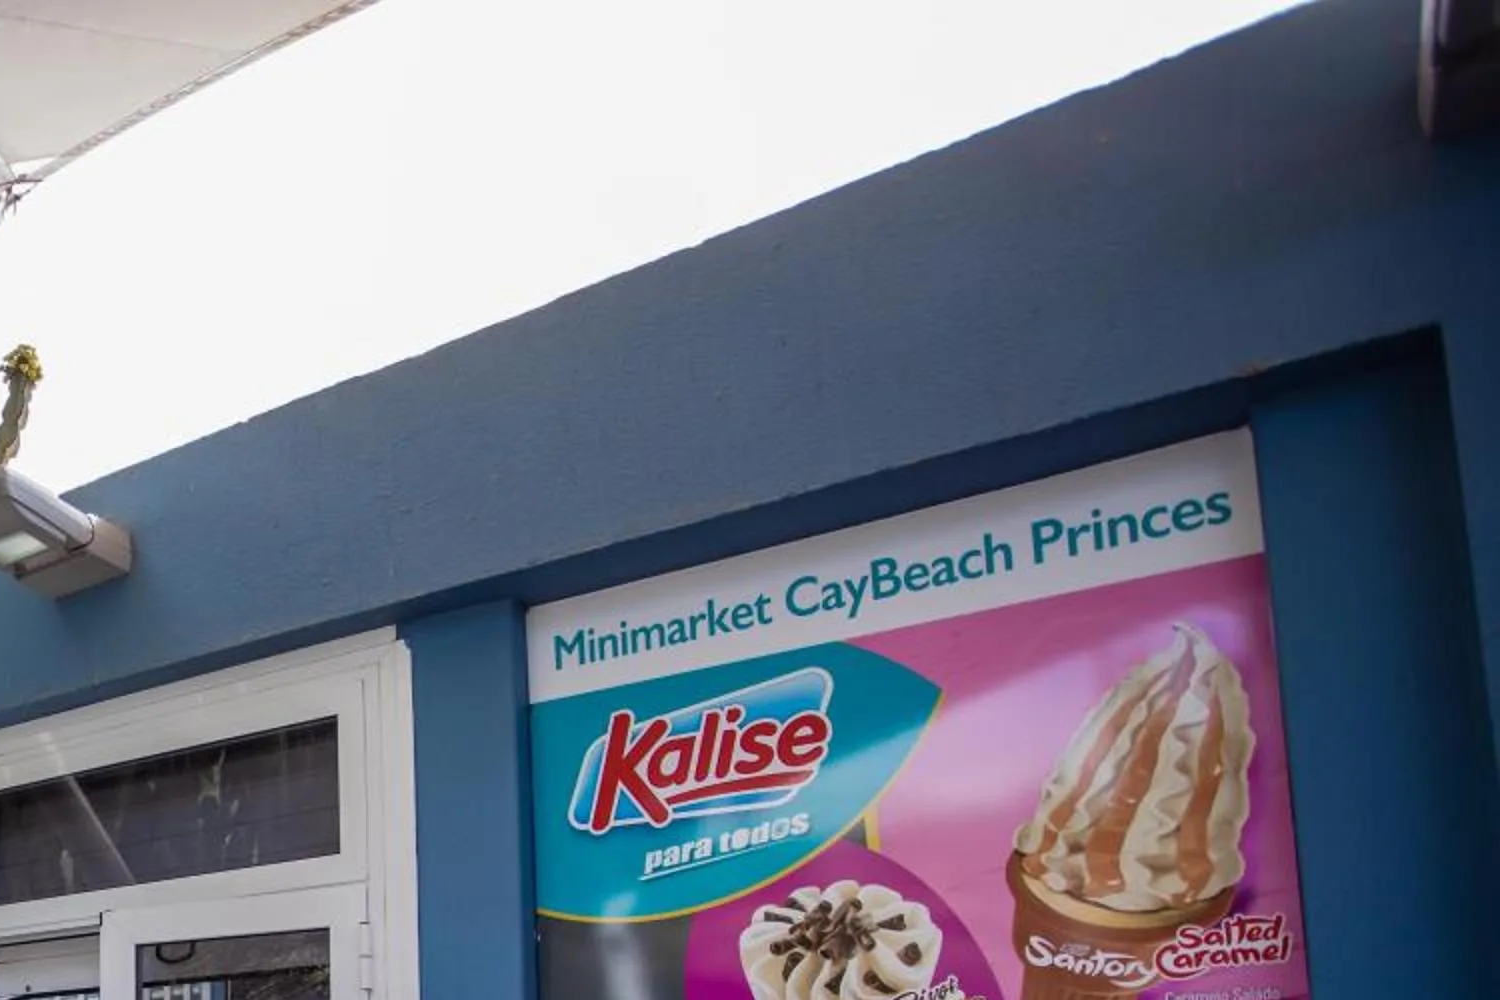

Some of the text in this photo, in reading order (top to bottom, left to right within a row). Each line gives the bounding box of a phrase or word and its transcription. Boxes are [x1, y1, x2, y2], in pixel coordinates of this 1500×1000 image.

[552, 492, 1233, 671] Minimarket CayBeach Princes
[589, 706, 832, 835] Kalise
[642, 812, 812, 876] para todos
[1024, 934, 1157, 989] Santory
[1154, 934, 1292, 980] Caramel
[1177, 914, 1284, 950] Salted
